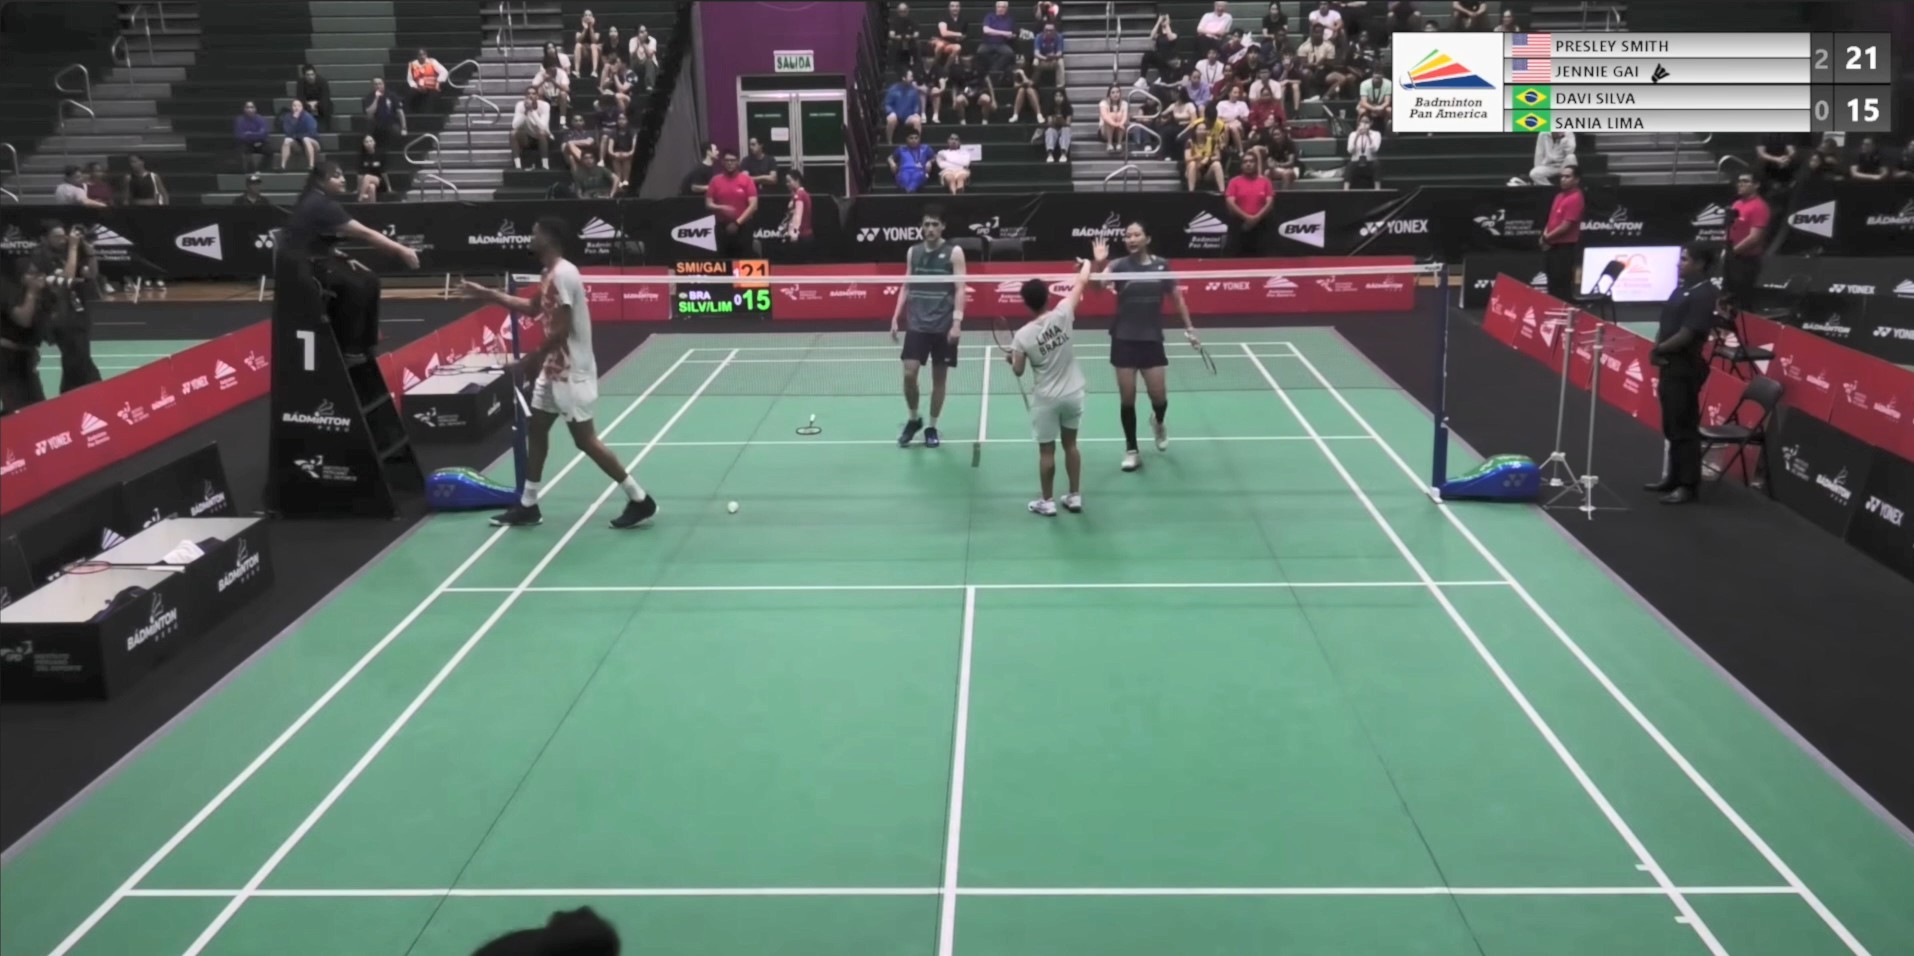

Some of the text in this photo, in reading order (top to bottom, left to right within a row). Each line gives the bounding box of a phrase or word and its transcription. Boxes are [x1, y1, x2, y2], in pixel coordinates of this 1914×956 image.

[776, 56, 811, 69] SALIDA
[1793, 213, 1831, 224] BWF
[1285, 224, 1321, 234] BWF
[1387, 219, 1429, 234] YONEX
[677, 228, 712, 238] BWF
[883, 227, 924, 240] YONEX
[181, 237, 216, 246] BWF
[676, 262, 727, 273] SMI/GAI
[1222, 282, 1250, 290] YONEX
[1847, 284, 1876, 294] YONEX
[689, 291, 711, 300] BRA
[734, 294, 742, 305] 0
[743, 289, 771, 310] 15
[678, 301, 733, 312] SILV/LIM
[1036, 325, 1062, 346] LIMA
[1039, 333, 1070, 356] BRAZIL
[296, 330, 315, 371] 1
[48, 431, 72, 450] YONEX
[1880, 501, 1904, 527] YONEX
